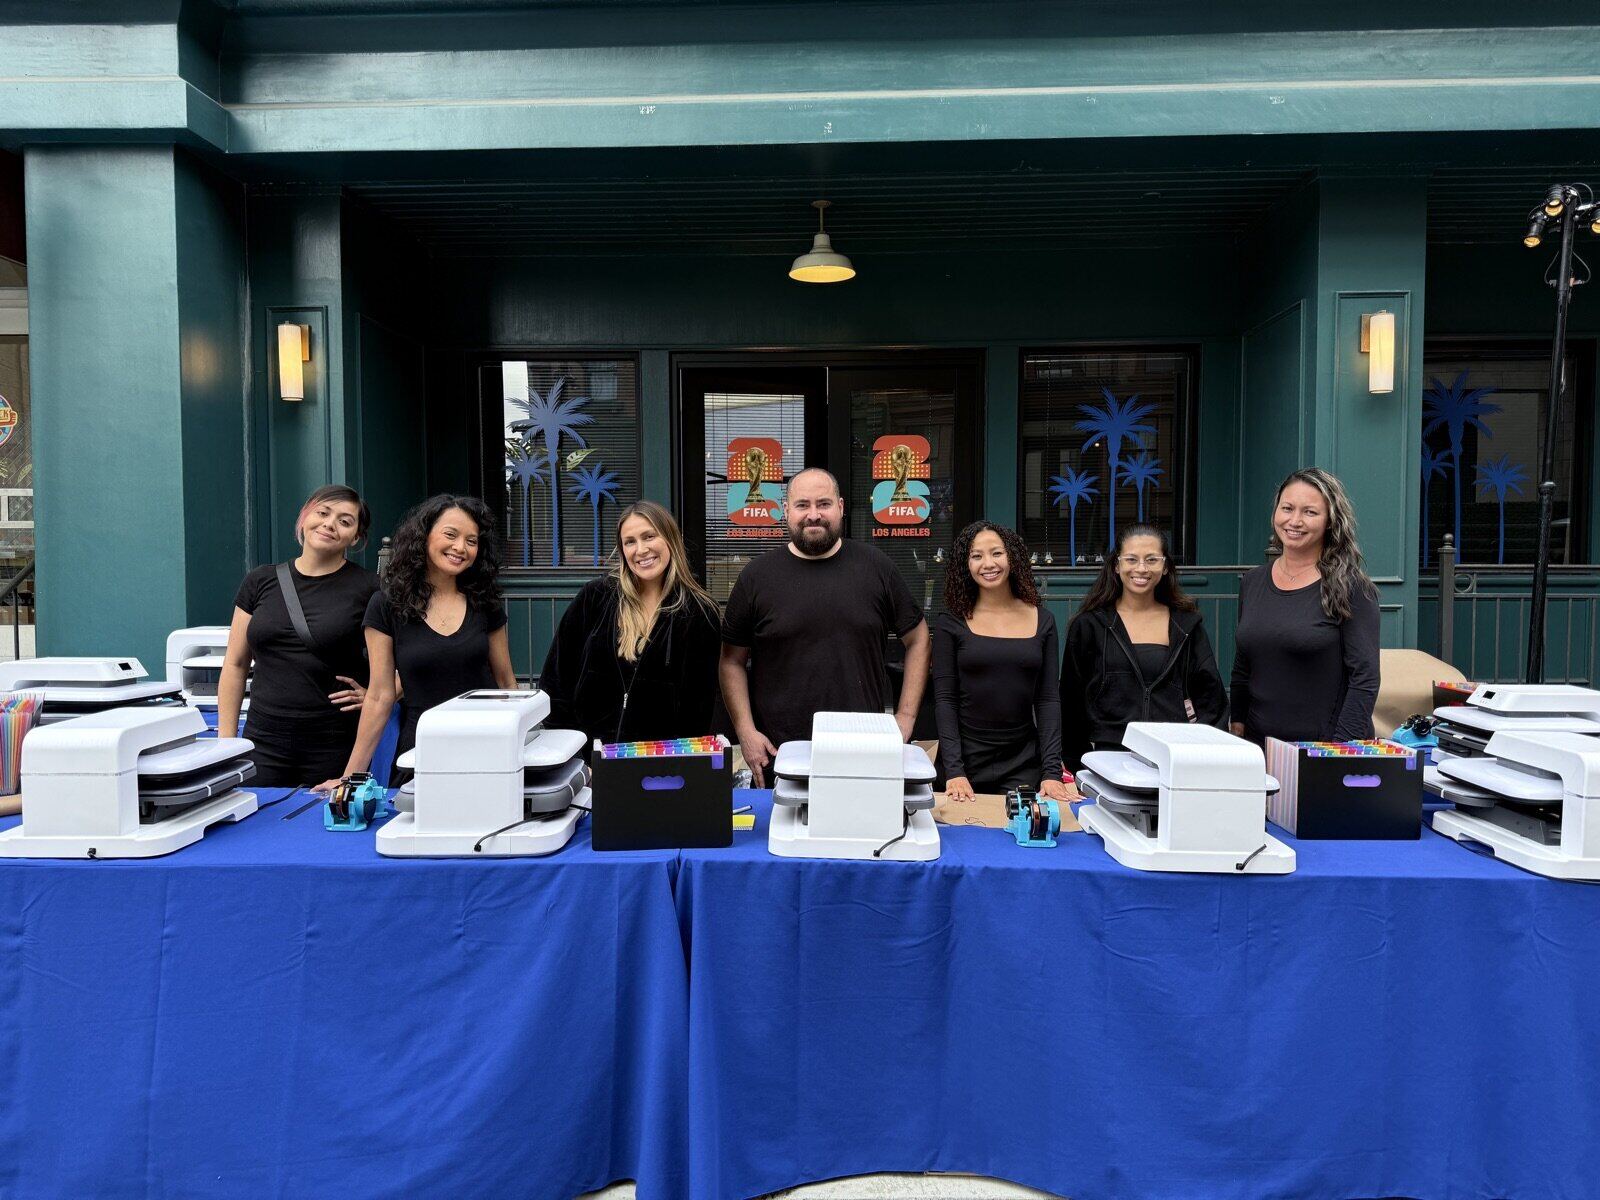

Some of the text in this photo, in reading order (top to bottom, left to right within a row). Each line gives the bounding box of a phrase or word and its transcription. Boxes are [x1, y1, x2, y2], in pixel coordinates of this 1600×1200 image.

[743, 508, 769, 517] FIFA
[888, 506, 915, 516] FIFA
[727, 528, 784, 538] LOS ANGELES
[872, 528, 930, 537] LOS ANGELES
